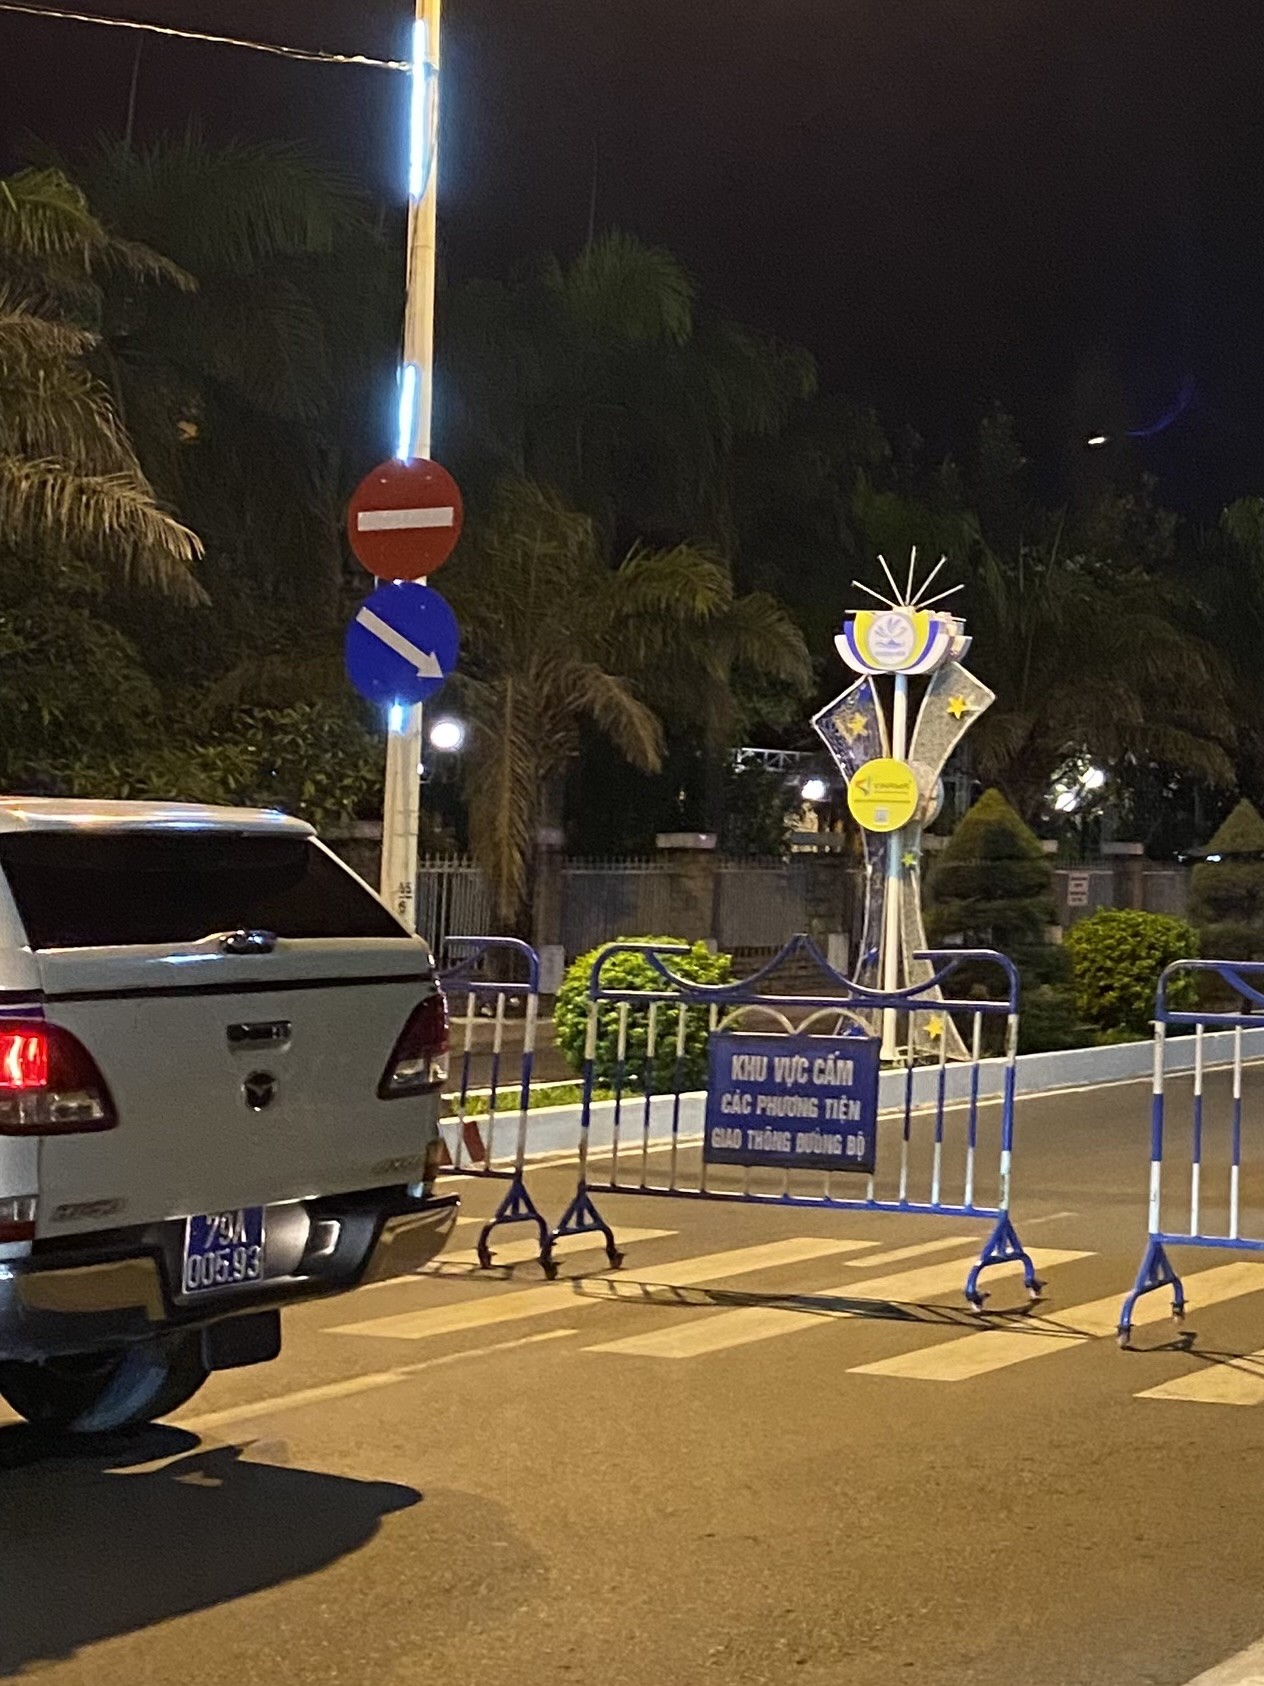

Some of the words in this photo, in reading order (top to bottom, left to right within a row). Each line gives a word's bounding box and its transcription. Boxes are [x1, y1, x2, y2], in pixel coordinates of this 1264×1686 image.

[731, 1054, 768, 1082] KHU
[773, 1053, 809, 1087] VỰC
[812, 1050, 854, 1086] CẤM
[720, 1089, 752, 1115] CÁC
[755, 1094, 819, 1118] PHƯƠNG
[825, 1095, 861, 1124] TIỆN
[711, 1126, 742, 1149] GIAO
[747, 1126, 791, 1152] THÔNG
[846, 1130, 866, 1161] BỘ
[205, 1210, 247, 1249] 79A
[187, 1244, 261, 1288] 005.93
